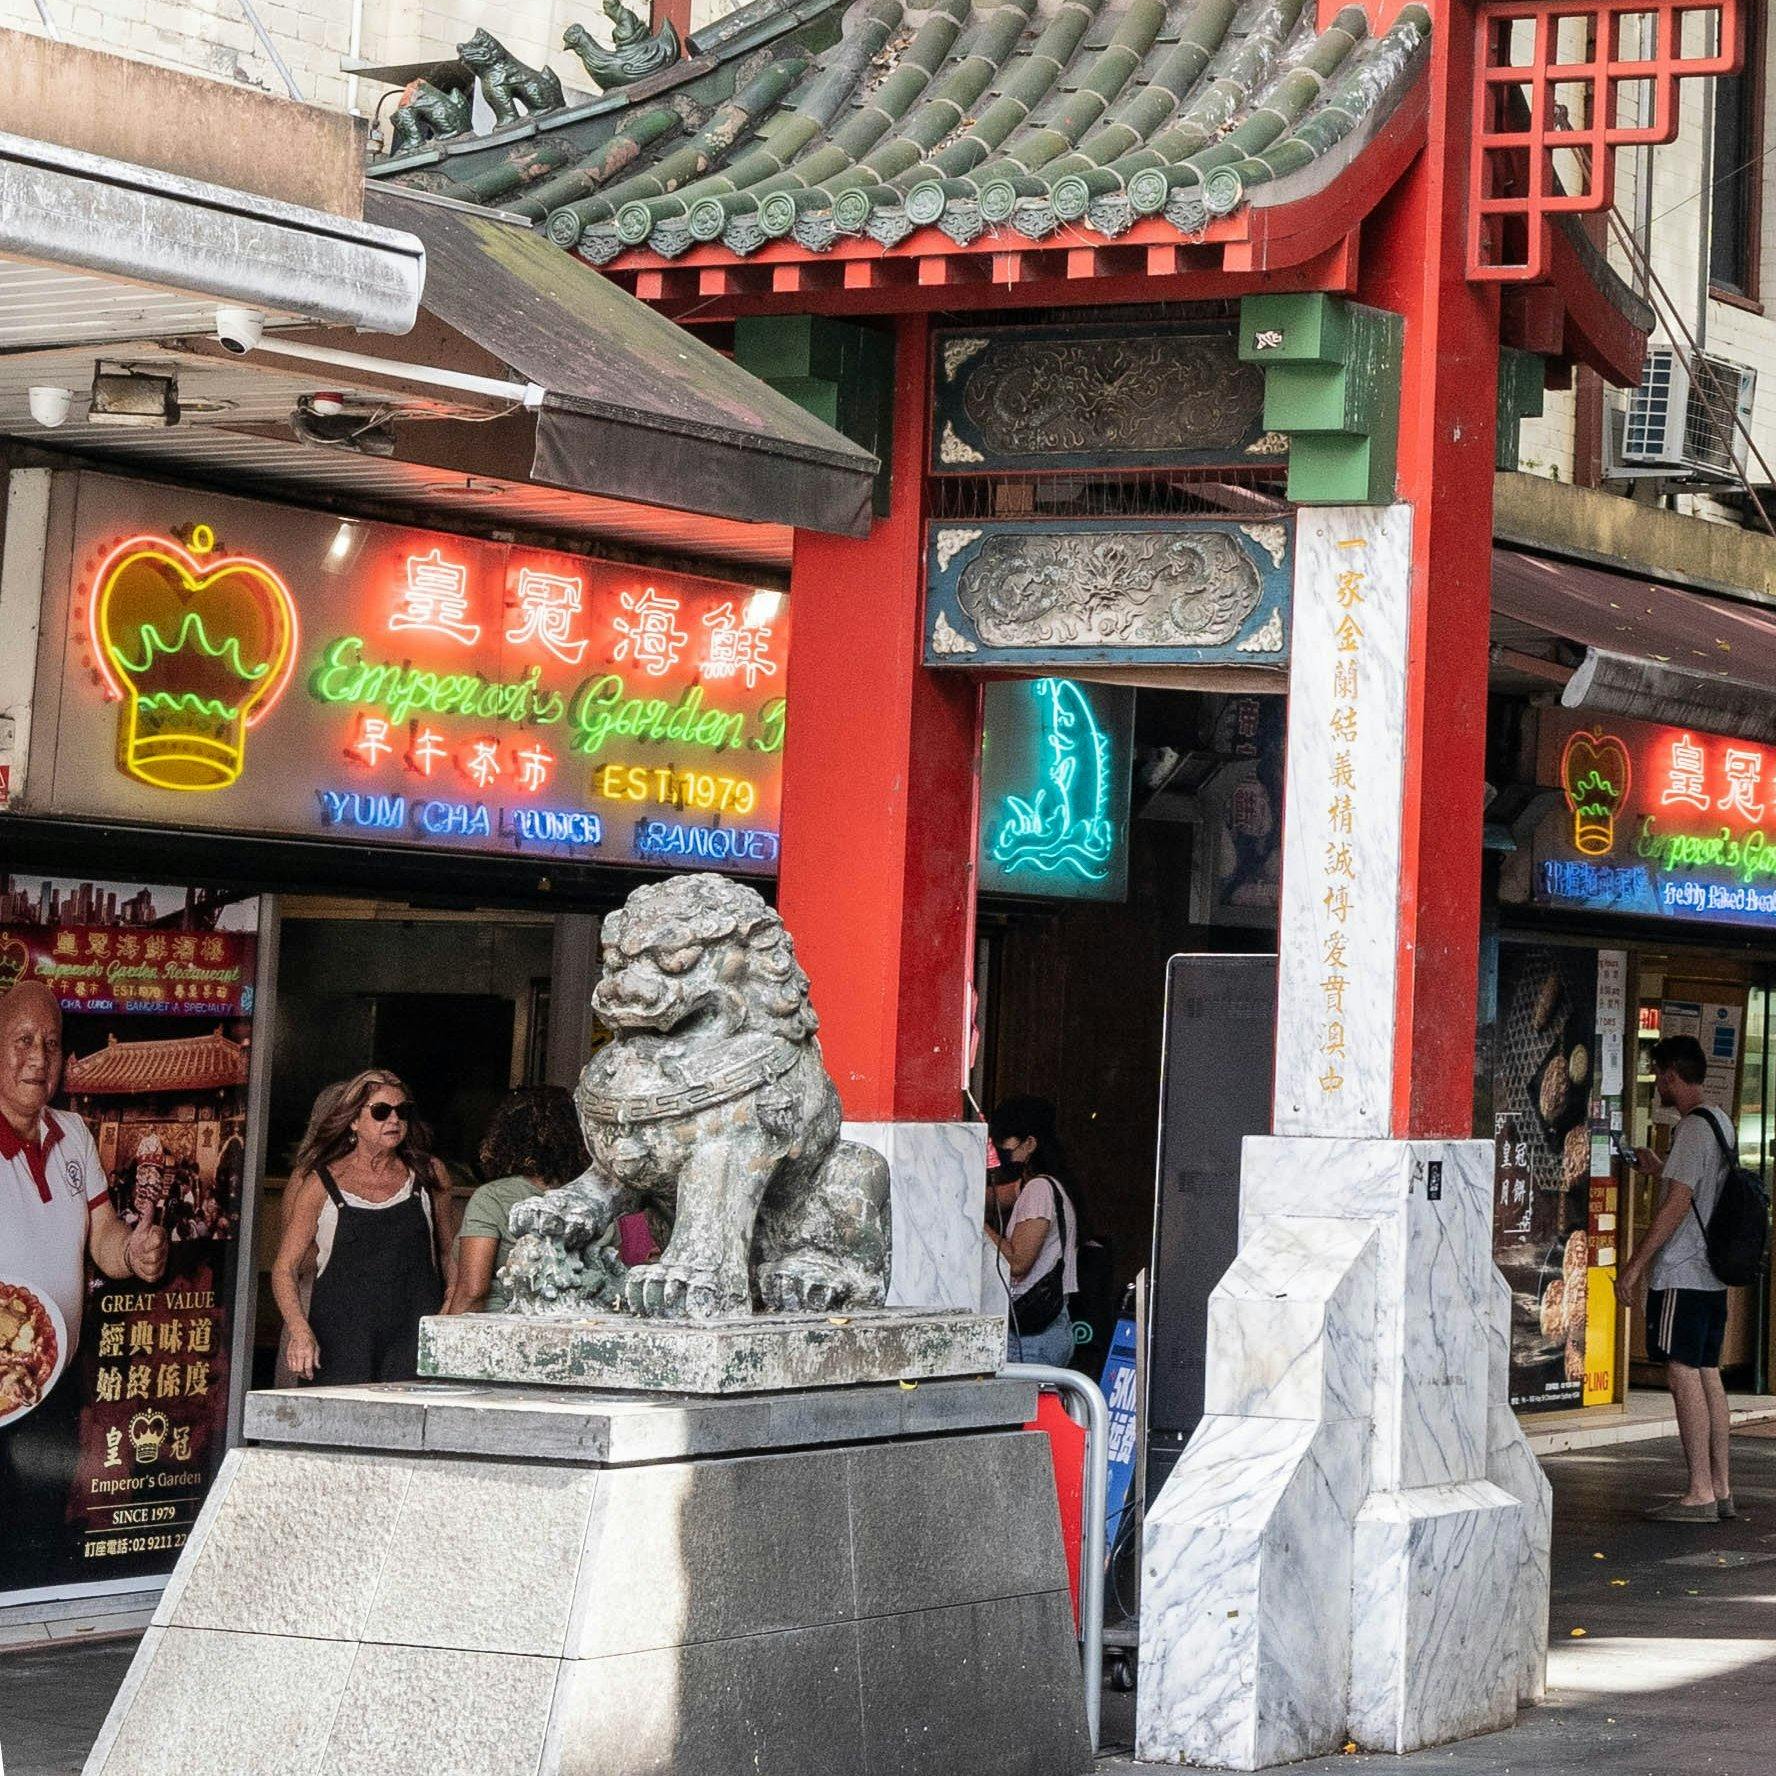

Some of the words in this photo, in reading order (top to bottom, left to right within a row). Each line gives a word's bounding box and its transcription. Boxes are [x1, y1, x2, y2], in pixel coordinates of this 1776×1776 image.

[389, 548, 777, 689] 皇冠海鮮
[318, 635, 565, 727] Emperor's
[576, 671, 744, 754] Garden
[353, 719, 553, 792] 早午茶市
[323, 790, 404, 829] YUM
[422, 800, 491, 836] CHA
[101, 1292, 156, 1314] GREAT
[165, 1290, 216, 1310] VALUE
[98, 1317, 213, 1357] 經典味道
[96, 1361, 210, 1402] 始終係度
[103, 1425, 123, 1469] 皇
[169, 1425, 192, 1462] 冠
[90, 1473, 156, 1494] Emperor's
[158, 1471, 202, 1488] Garden
[112, 1507, 149, 1525] SINCE
[151, 1506, 176, 1523] 1979
[147, 1535, 173, 1552] 9211
